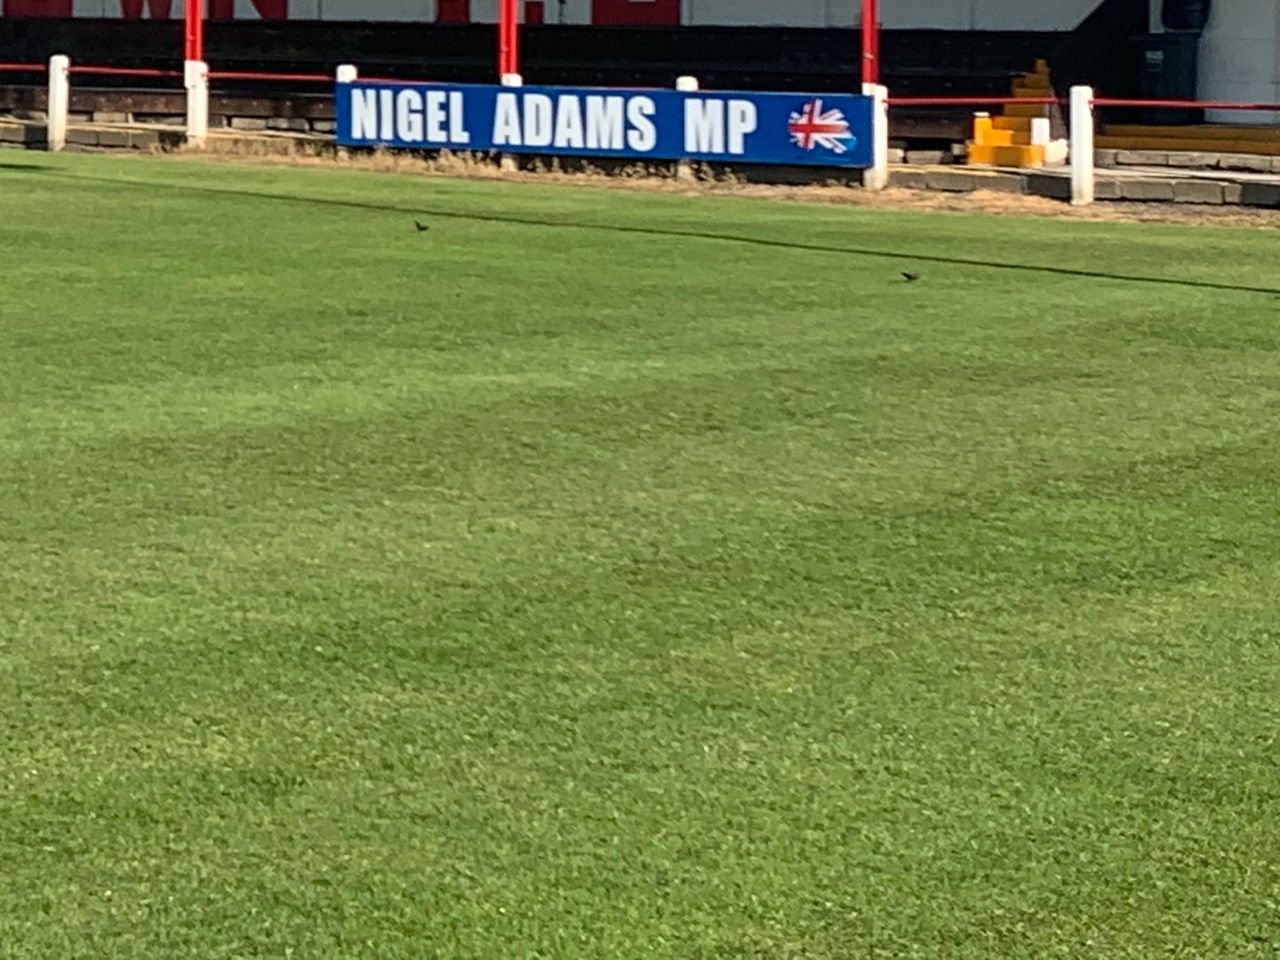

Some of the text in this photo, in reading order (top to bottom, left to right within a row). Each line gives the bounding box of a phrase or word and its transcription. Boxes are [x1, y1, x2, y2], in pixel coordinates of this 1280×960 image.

[350, 88, 758, 154] NIGEL ADAMS MP
